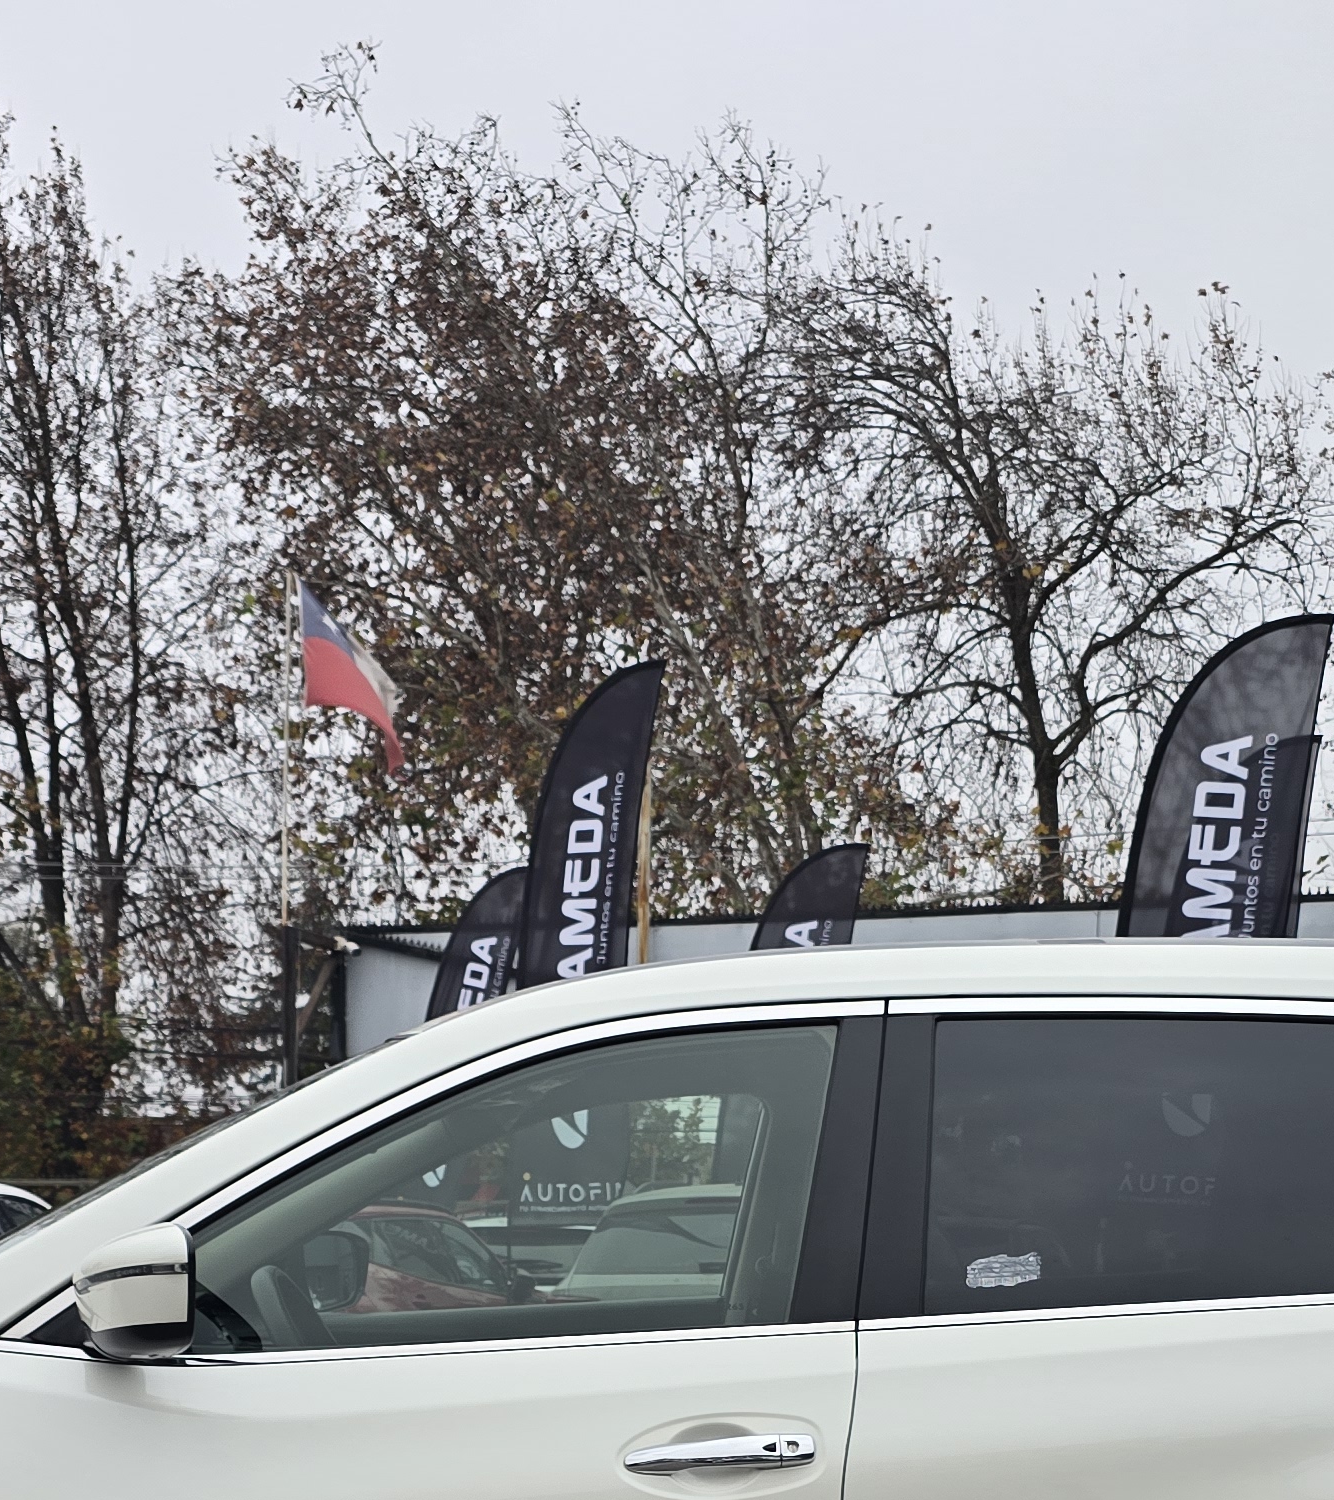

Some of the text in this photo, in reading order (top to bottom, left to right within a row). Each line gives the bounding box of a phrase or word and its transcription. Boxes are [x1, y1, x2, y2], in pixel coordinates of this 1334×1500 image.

[1256, 733, 1280, 812] camino
[596, 770, 626, 965] Juntos en tu camino
[1249, 845, 1265, 871] en
[1251, 818, 1268, 838] tu
[556, 773, 609, 979] AMEDA
